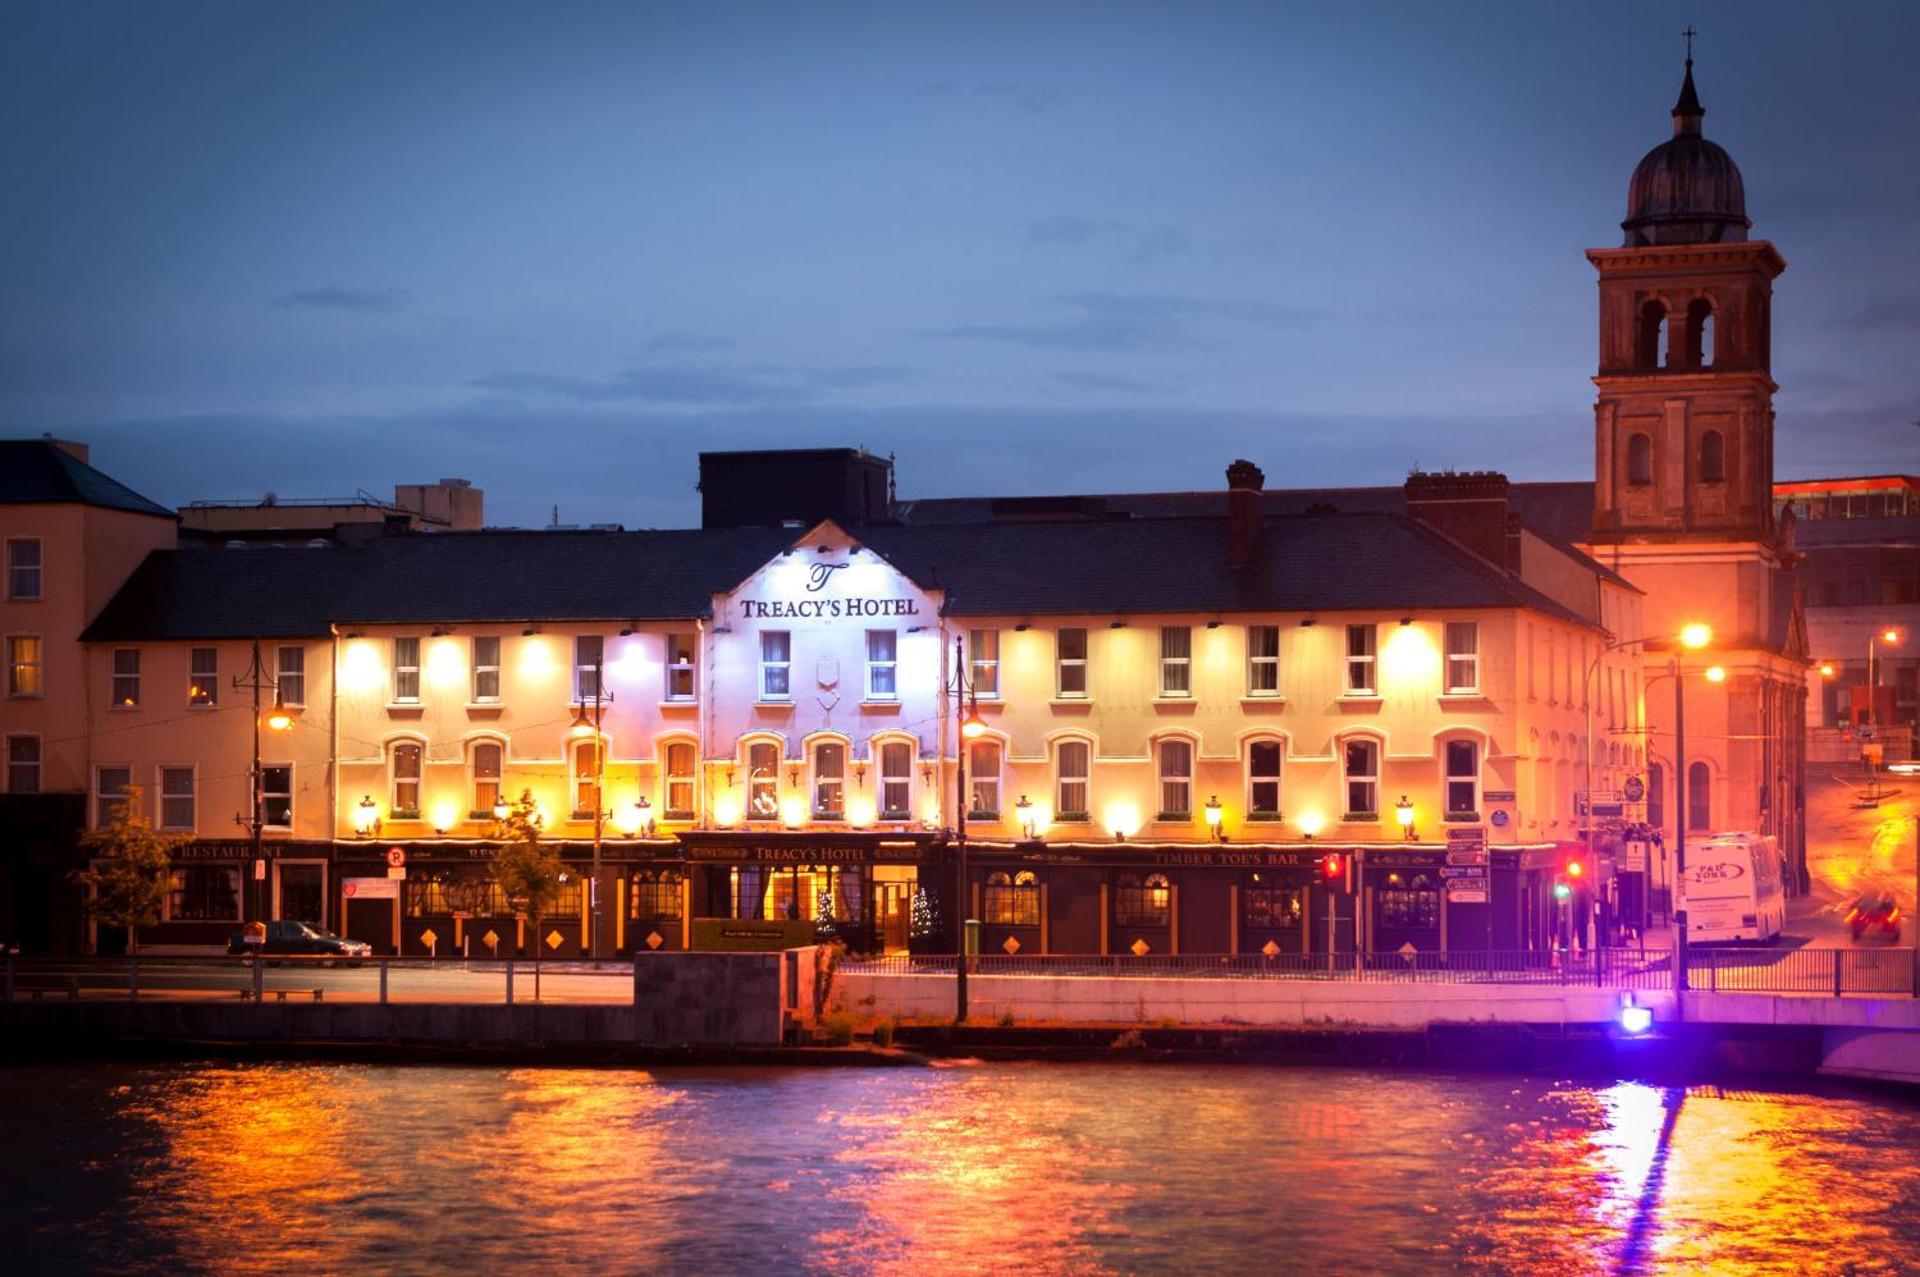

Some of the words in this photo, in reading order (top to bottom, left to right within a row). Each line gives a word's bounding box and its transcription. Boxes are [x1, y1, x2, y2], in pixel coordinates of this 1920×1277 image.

[740, 599, 841, 618] TREACY'S
[845, 598, 919, 616] HOTEL
[181, 845, 284, 858] RESTAURNT
[755, 847, 817, 861] TREACY'S
[821, 847, 866, 860] HOTEL
[1154, 853, 1212, 865] TIMBER
[1221, 853, 1262, 865] TOE'S
[1268, 853, 1299, 865] BAR
